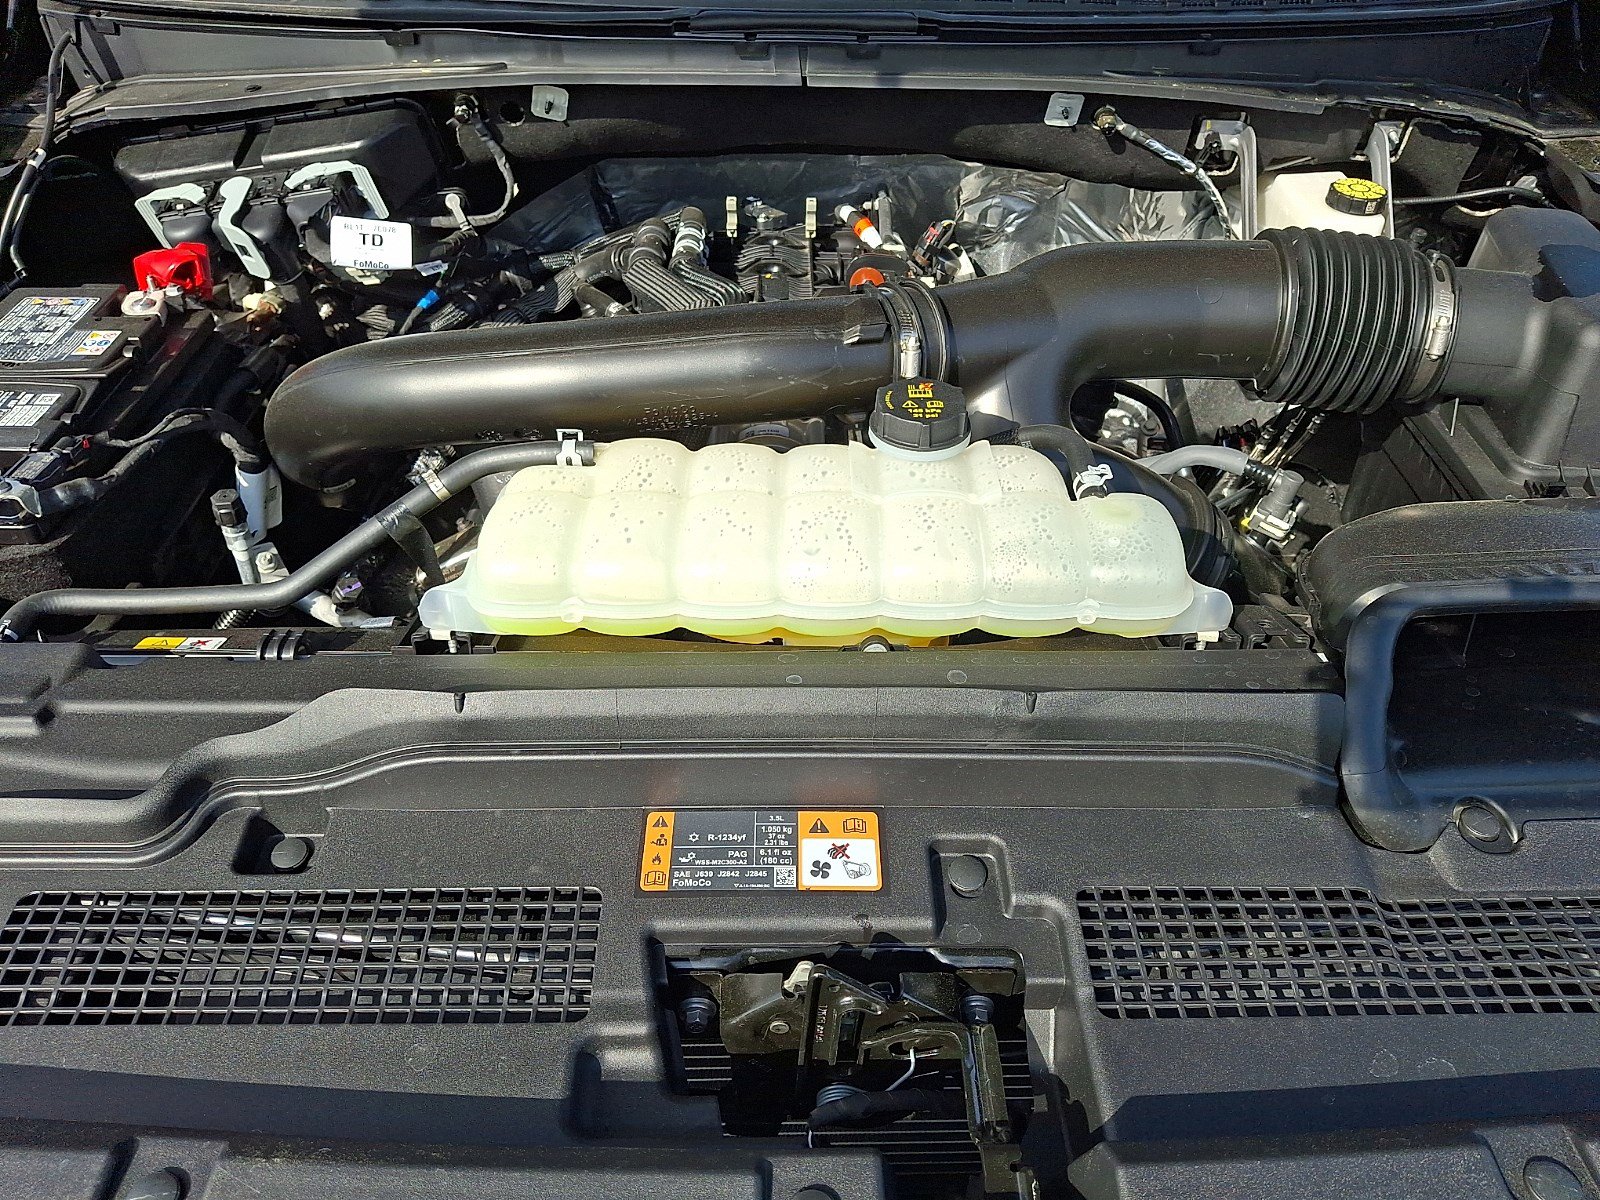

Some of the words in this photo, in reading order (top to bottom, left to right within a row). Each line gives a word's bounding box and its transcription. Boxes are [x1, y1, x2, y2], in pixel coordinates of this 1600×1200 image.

[359, 232, 384, 247] TD
[353, 259, 389, 269] FoMoCo
[761, 825, 781, 833] 1.050
[782, 825, 793, 834] kg
[707, 833, 747, 843] R-1234yf
[728, 850, 748, 858] PAG
[759, 848, 772, 856] 6.1
[773, 848, 780, 856] fl
[760, 857, 778, 866] (180
[779, 857, 793, 866] cc)
[673, 870, 691, 878] SAE
[695, 870, 714, 878] J639
[717, 870, 740, 878] J2842
[745, 870, 768, 878] J2845
[672, 879, 712, 887] FoMoCo
